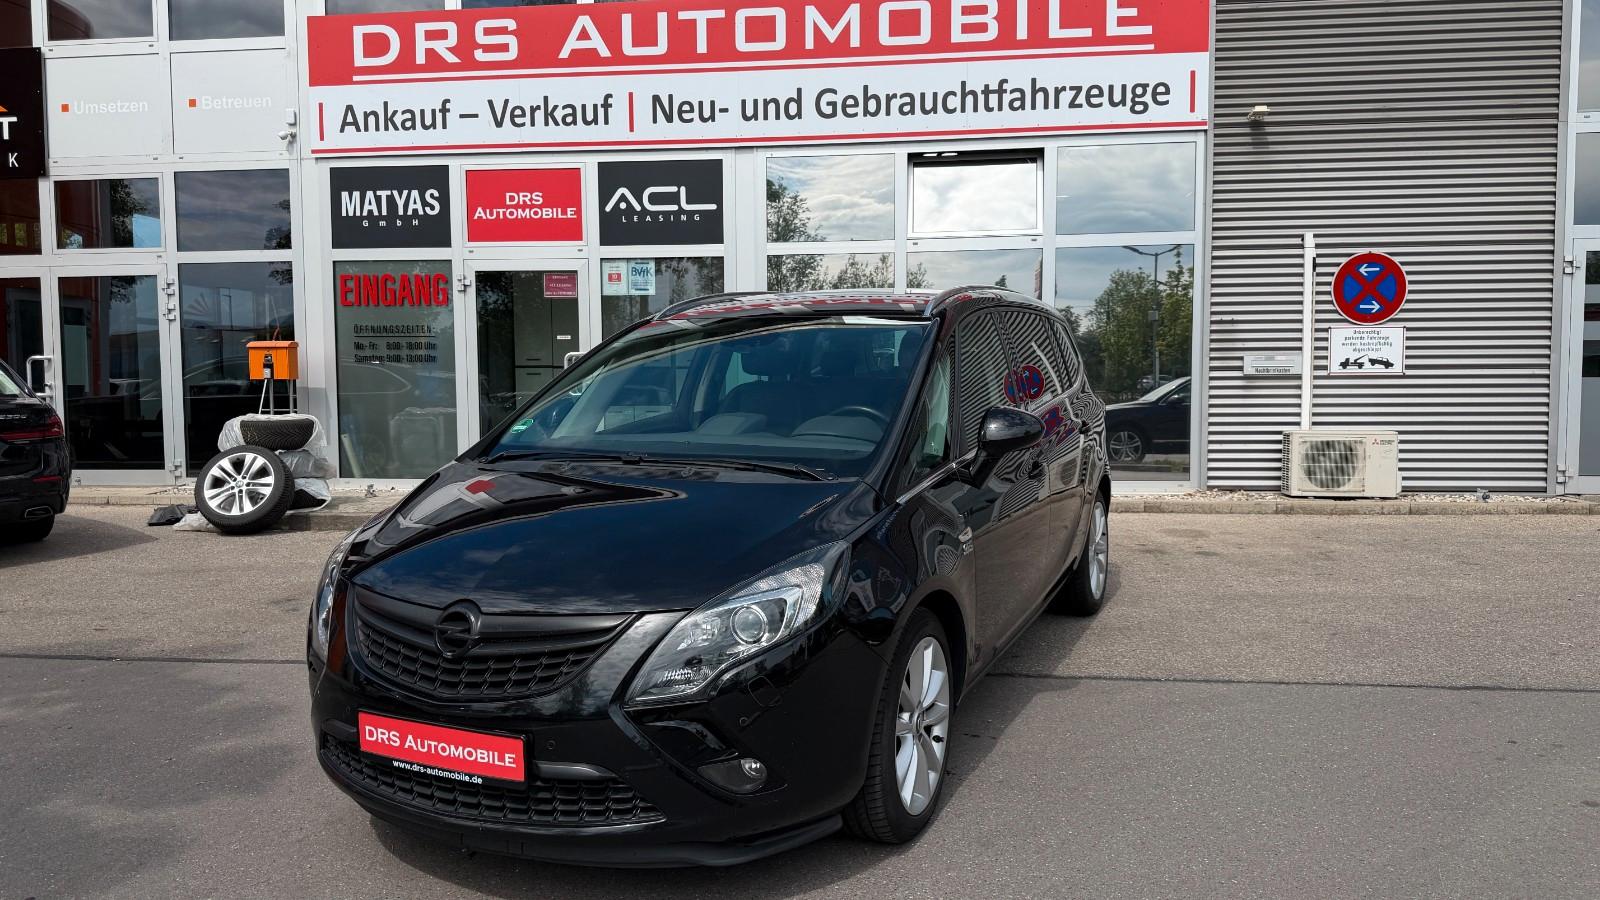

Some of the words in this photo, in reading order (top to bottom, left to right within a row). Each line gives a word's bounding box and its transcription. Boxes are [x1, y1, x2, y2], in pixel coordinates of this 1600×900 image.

[353, 18, 519, 67] DRS
[558, 0, 1153, 59] AUTOMOBILE
[74, 100, 149, 114] Umsetzen
[202, 96, 272, 109] Betreuen
[339, 99, 451, 133] Ankauf
[487, 93, 613, 128] Verkauf
[651, 94, 729, 124] Neu-
[740, 87, 803, 121] und
[814, 78, 1171, 119] Gebrauchtfahrzeuge
[341, 189, 440, 217] MATYAS
[505, 192, 543, 206] DRS
[604, 186, 718, 212] ACL
[362, 218, 419, 227] GmbH
[473, 206, 577, 220] AUTOMOBILE
[622, 214, 700, 223] LEASING
[339, 273, 449, 307] EINGANG
[365, 725, 401, 747] DRS
[404, 735, 517, 767] AUTOMOBILE
[392, 760, 483, 784] www.drs-automobile.de
